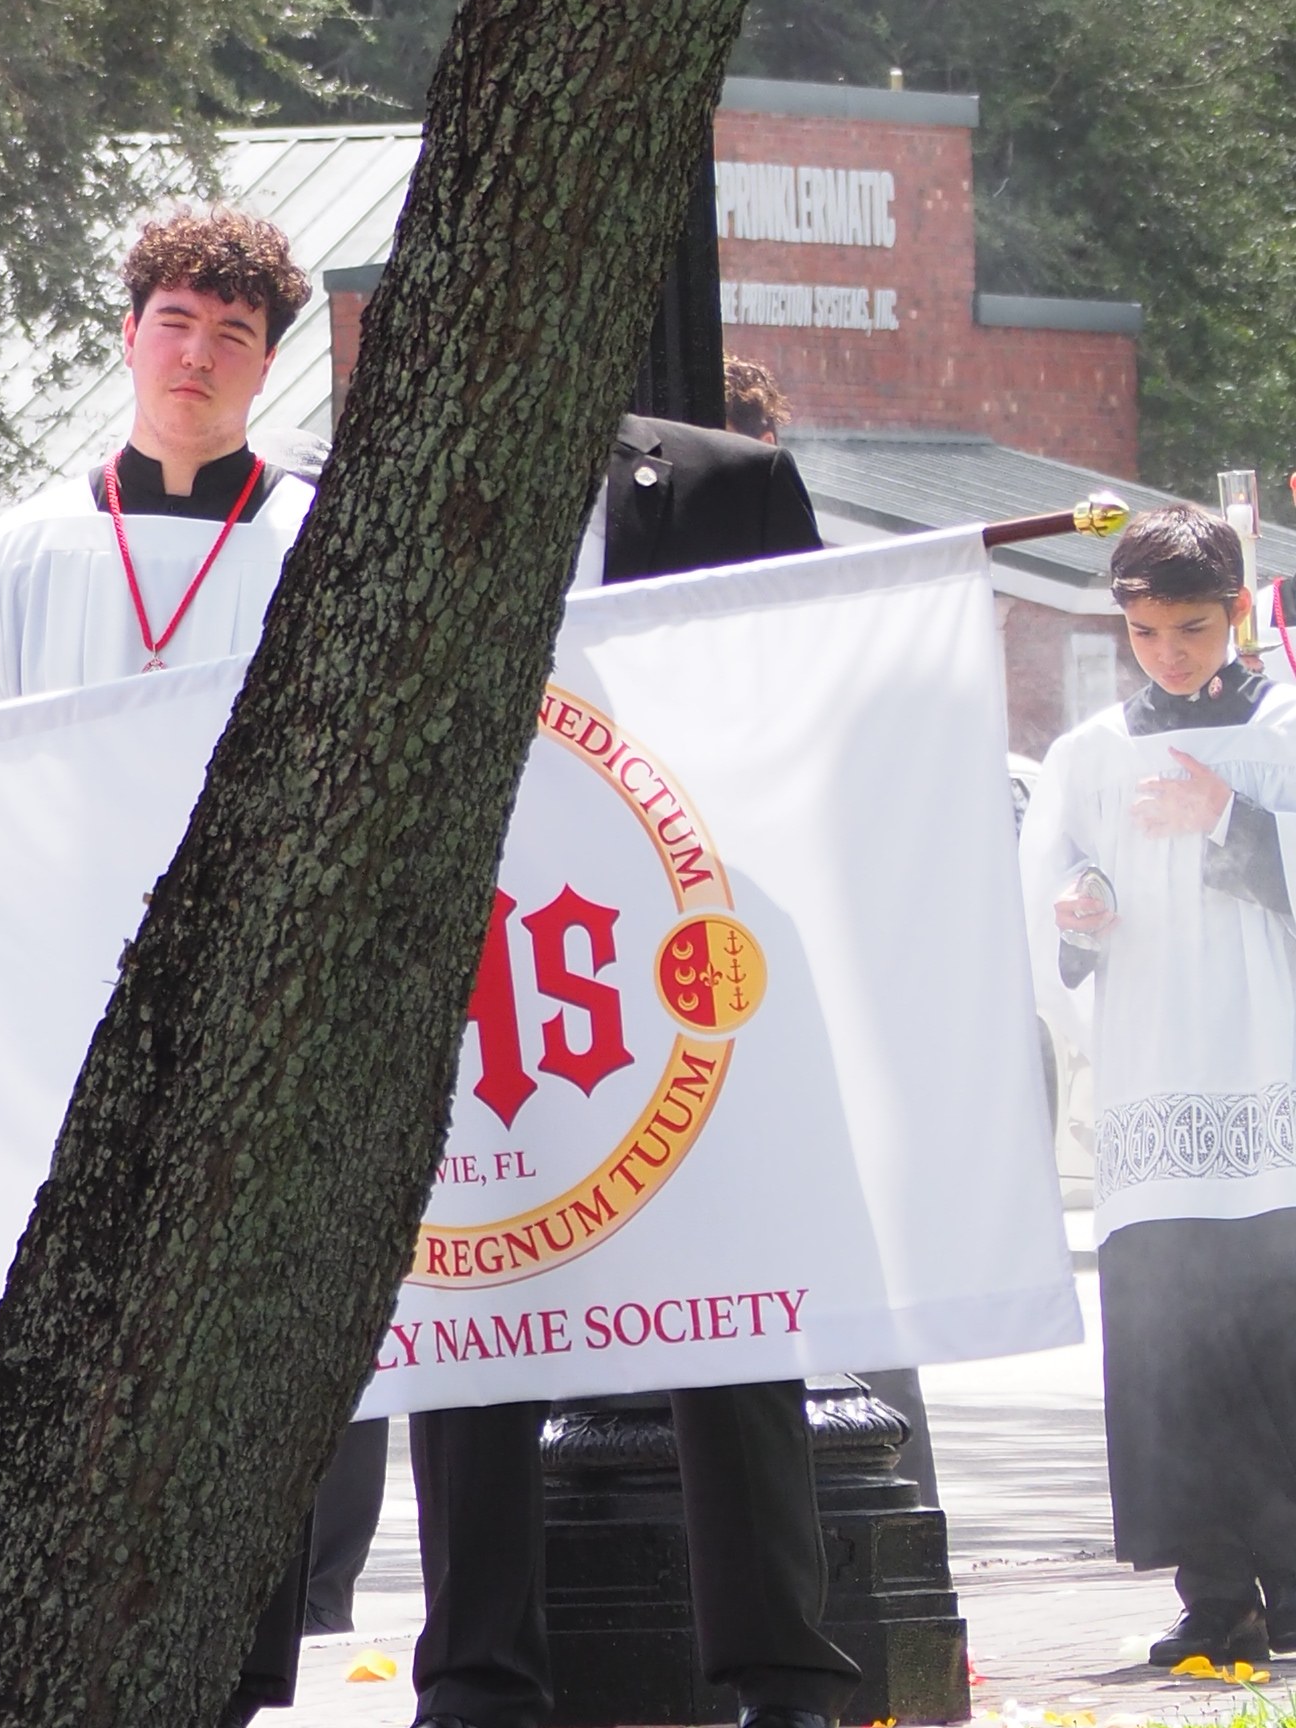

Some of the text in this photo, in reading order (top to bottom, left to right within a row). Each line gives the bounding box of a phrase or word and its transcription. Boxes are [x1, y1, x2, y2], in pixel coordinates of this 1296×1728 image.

[714, 161, 896, 248] PRINKLERMATIC
[426, 1050, 716, 1277] REGNUM TUUM
[494, 1151, 537, 1181] FL
[432, 1310, 572, 1364] NAME
[585, 1288, 810, 1351] SOCIETY
